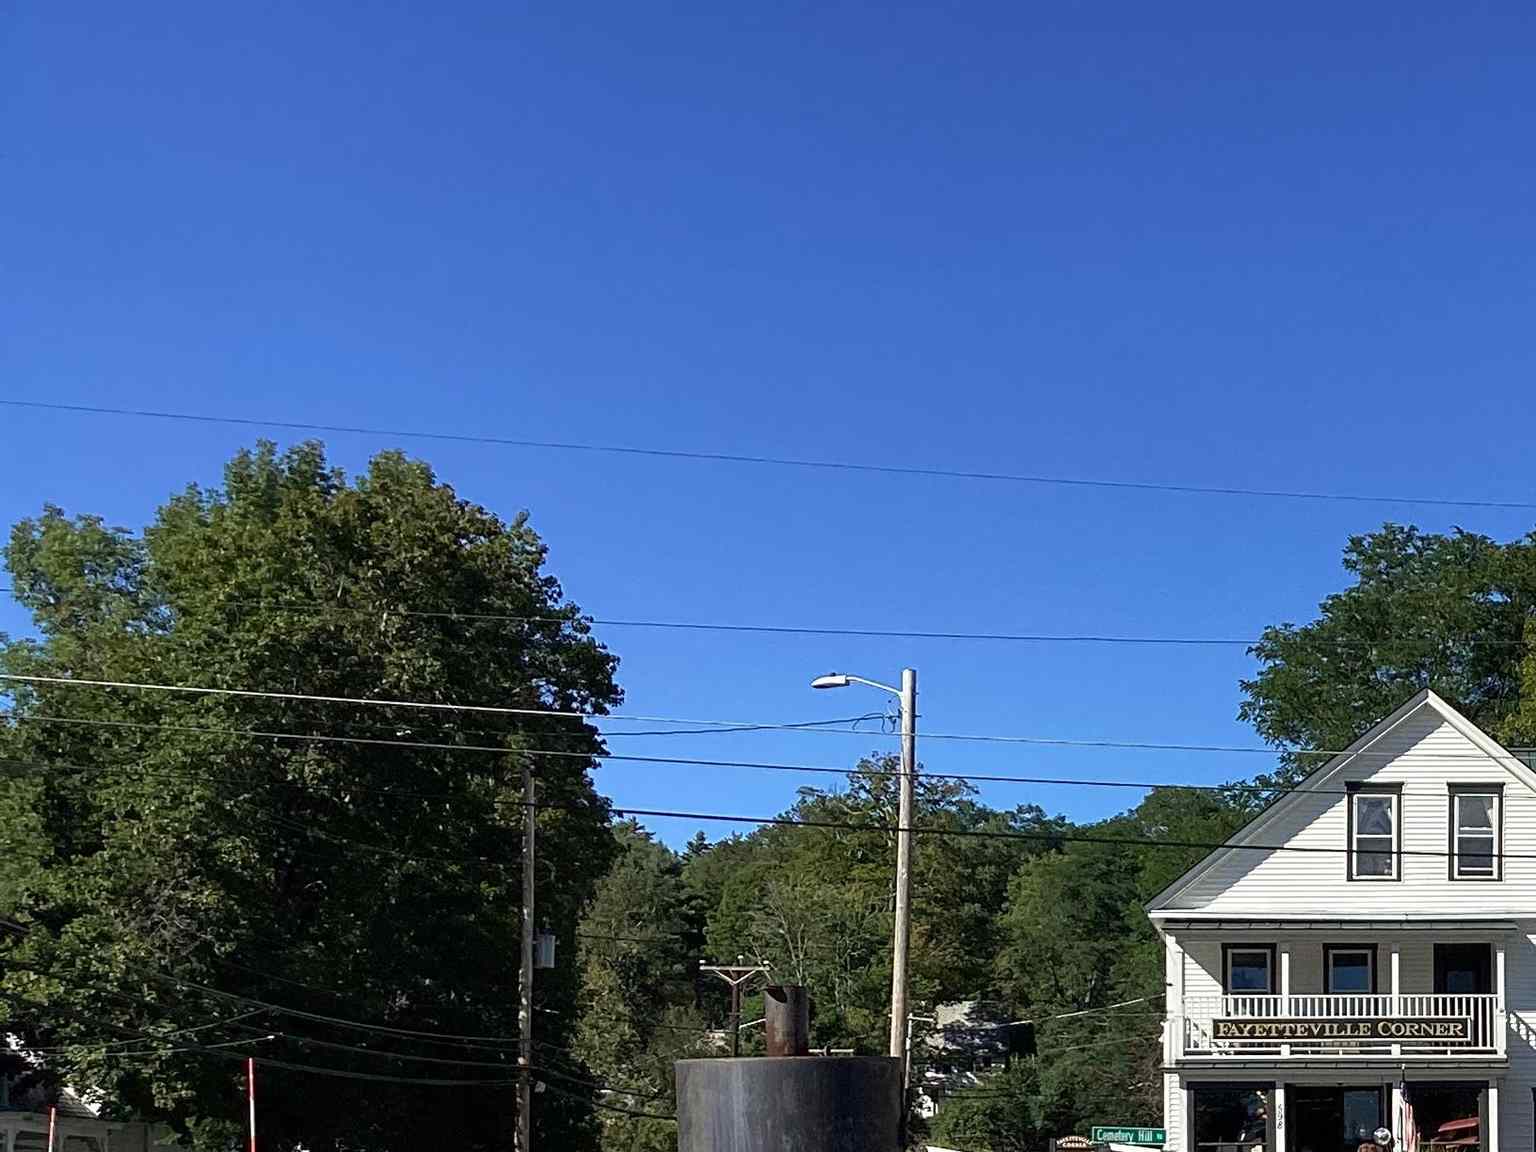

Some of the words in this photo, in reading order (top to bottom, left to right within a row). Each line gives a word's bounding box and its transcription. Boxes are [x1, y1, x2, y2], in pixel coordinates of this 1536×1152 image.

[1217, 1022, 1372, 1037] FAYETTEVILLE
[1377, 1021, 1464, 1037] CORNER
[1097, 1129, 1134, 1143] Cemetery
[1138, 1130, 1153, 1142] Hill
